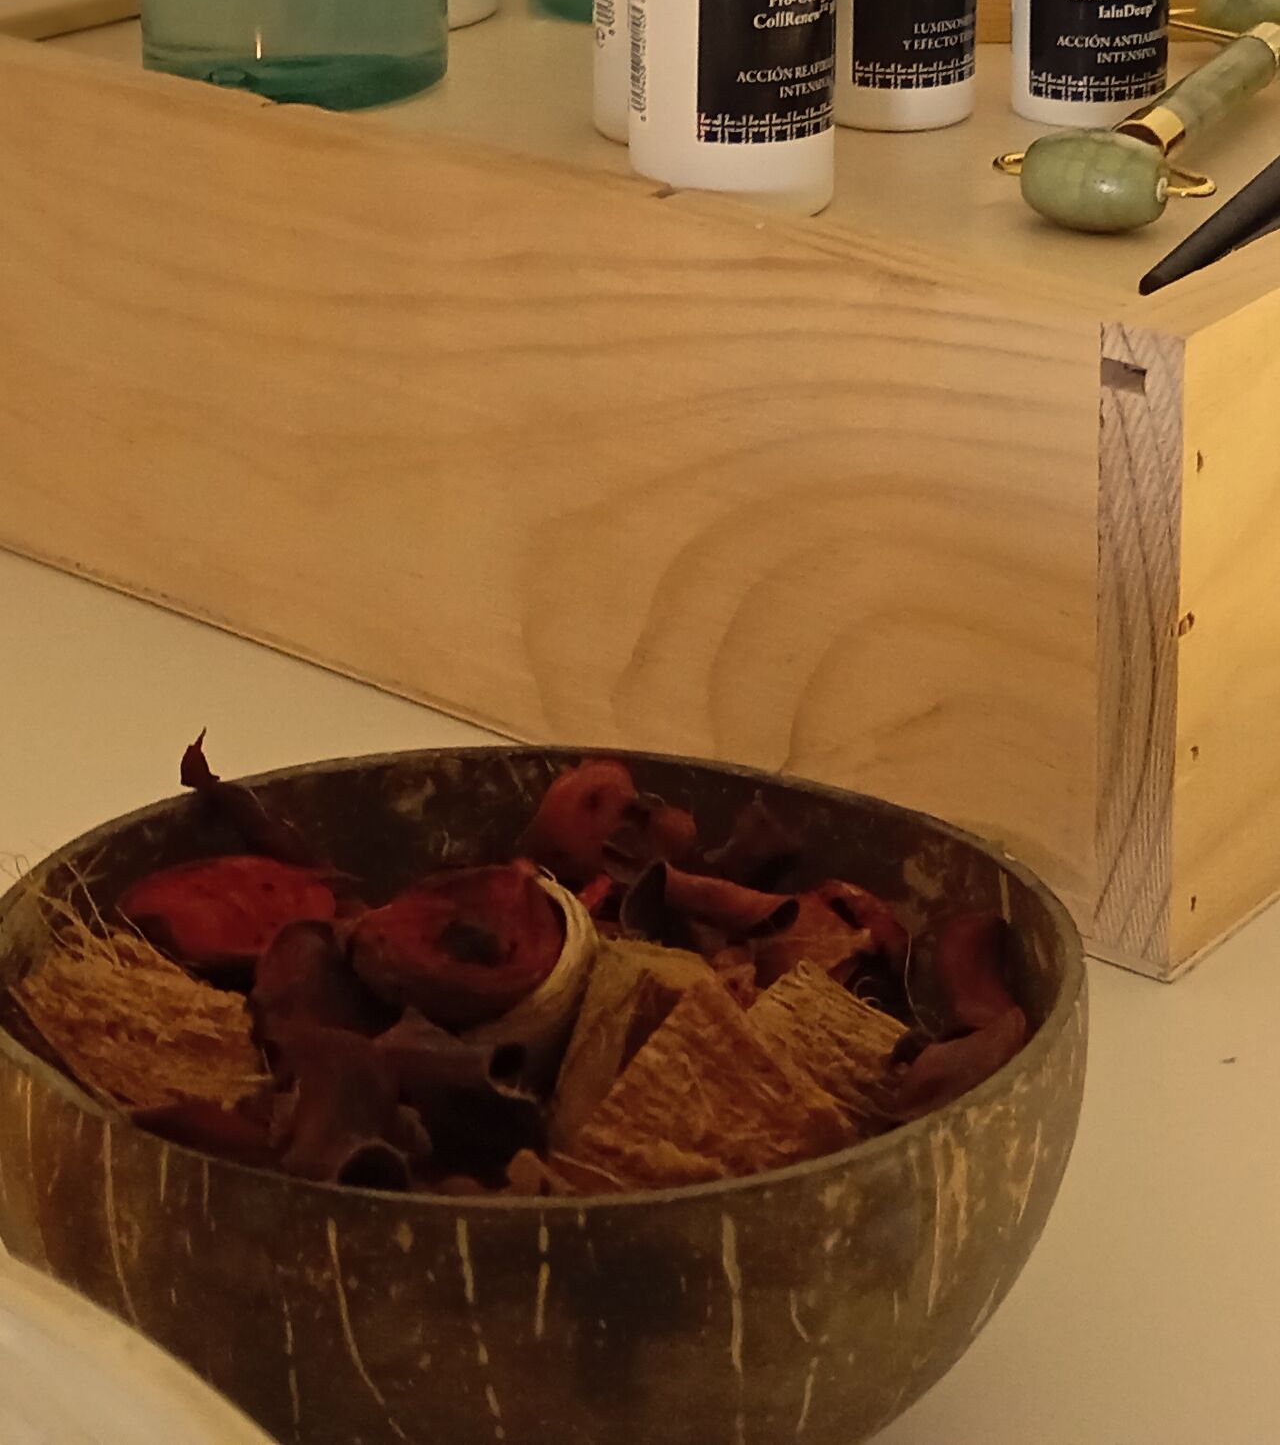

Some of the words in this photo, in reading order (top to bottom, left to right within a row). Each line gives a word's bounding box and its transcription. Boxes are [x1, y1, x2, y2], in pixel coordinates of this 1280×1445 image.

[902, 39, 912, 51] Y
[1056, 33, 1111, 49] ACCIÓN
[736, 65, 793, 84] ACCIÓN
